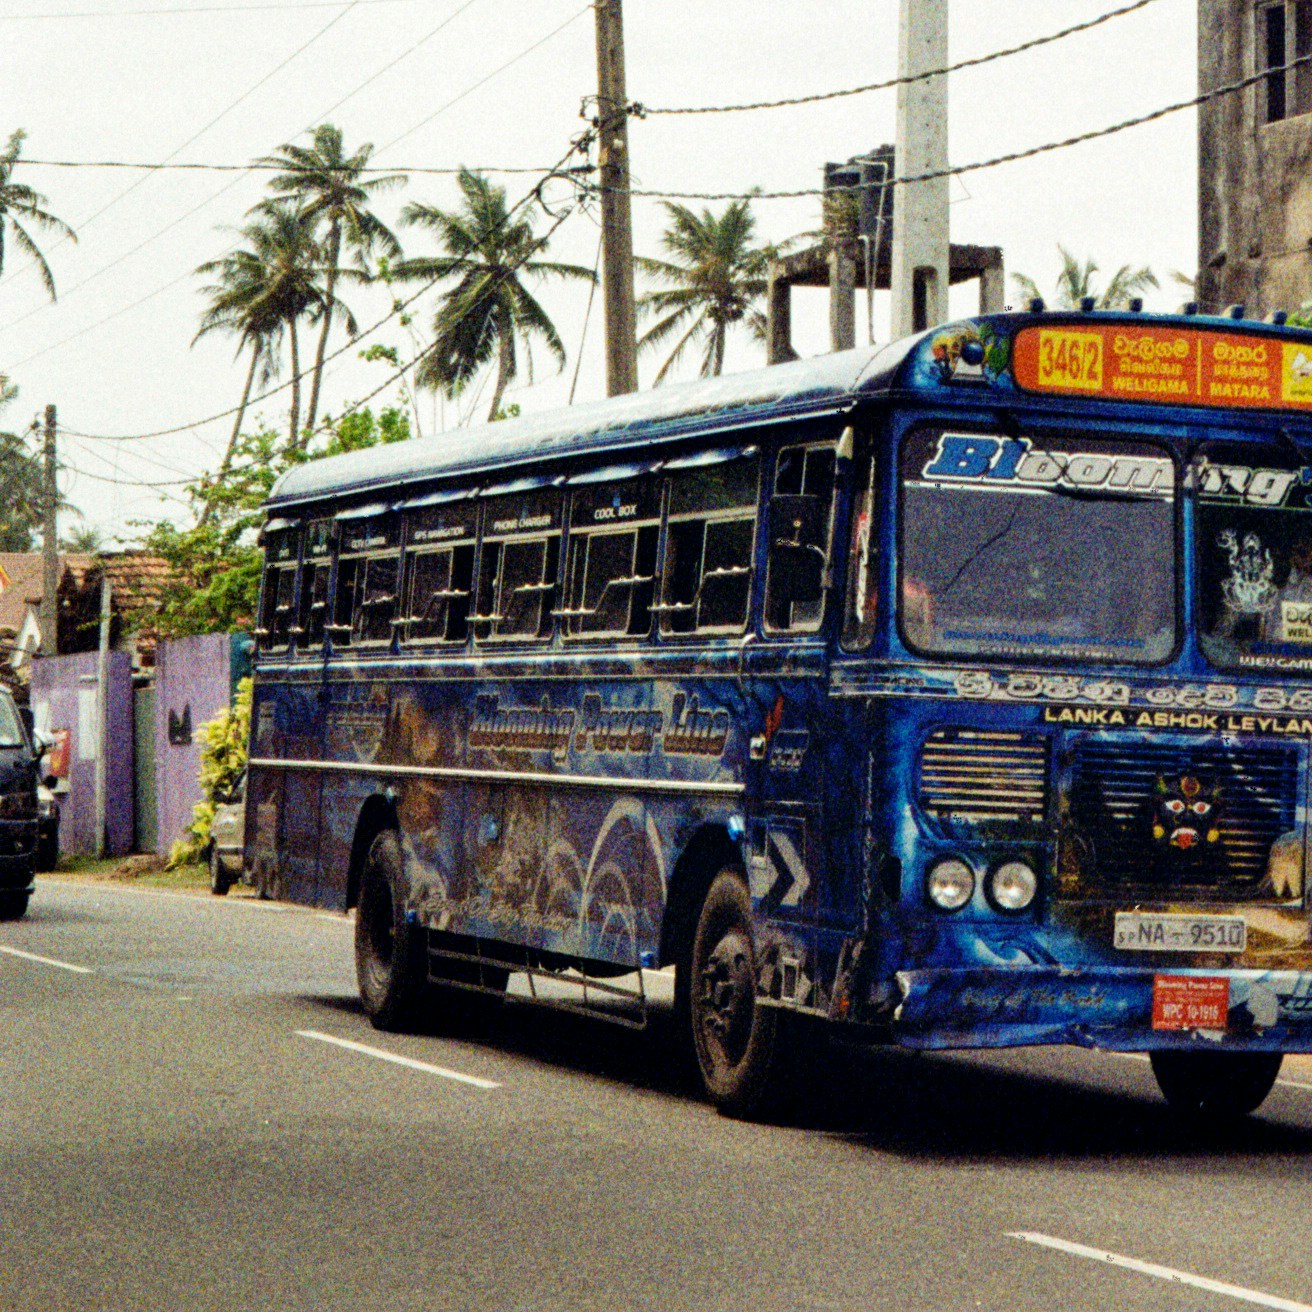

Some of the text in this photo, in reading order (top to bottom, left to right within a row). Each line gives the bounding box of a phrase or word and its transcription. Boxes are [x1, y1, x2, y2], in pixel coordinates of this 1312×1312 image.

[1042, 338, 1099, 381] 346/2
[1112, 376, 1190, 394] WELIGAMA
[1209, 382, 1271, 400] MATARA
[594, 505, 638, 520] COOL BOX
[493, 515, 551, 531] PHONE CHARGER
[1044, 707, 1126, 725] LANKA
[1136, 711, 1218, 730] ASHOK
[1138, 922, 1166, 944] NA
